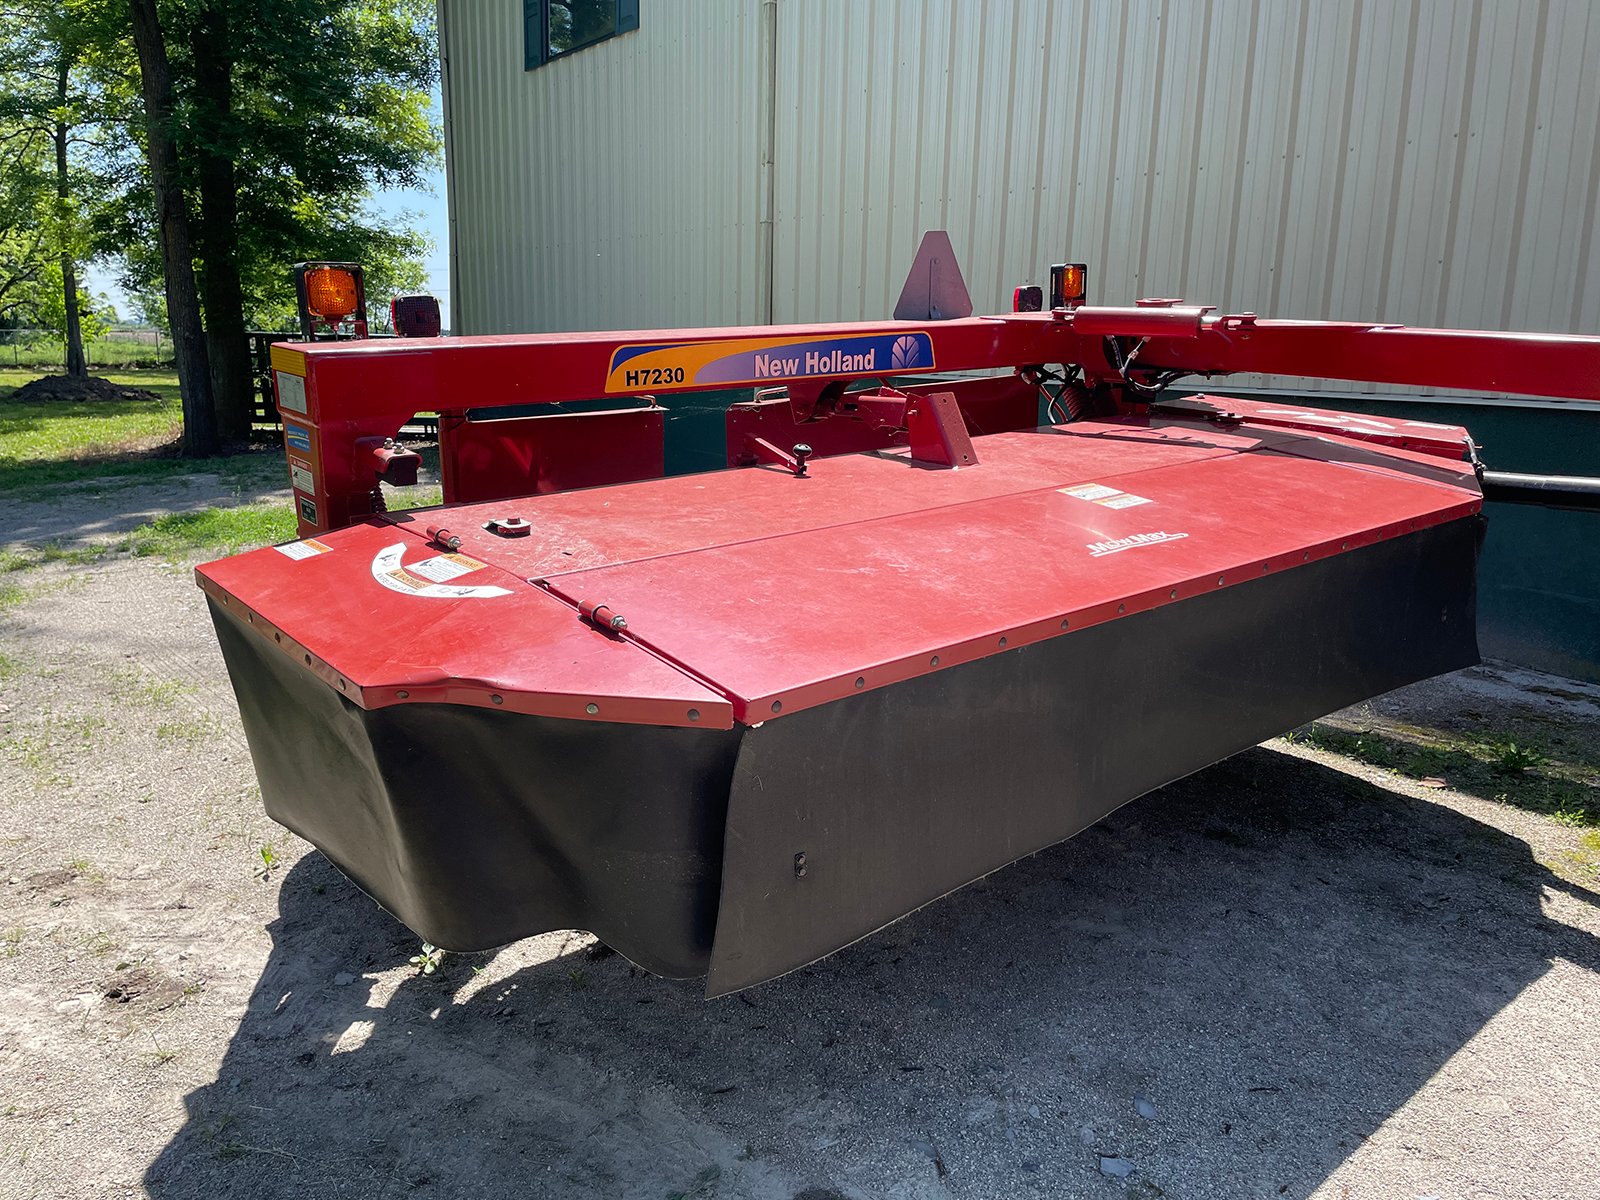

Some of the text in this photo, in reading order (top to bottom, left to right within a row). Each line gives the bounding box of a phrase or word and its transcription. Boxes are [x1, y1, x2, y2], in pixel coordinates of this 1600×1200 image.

[754, 348, 876, 378] New Holland
[625, 367, 685, 387] H7230
